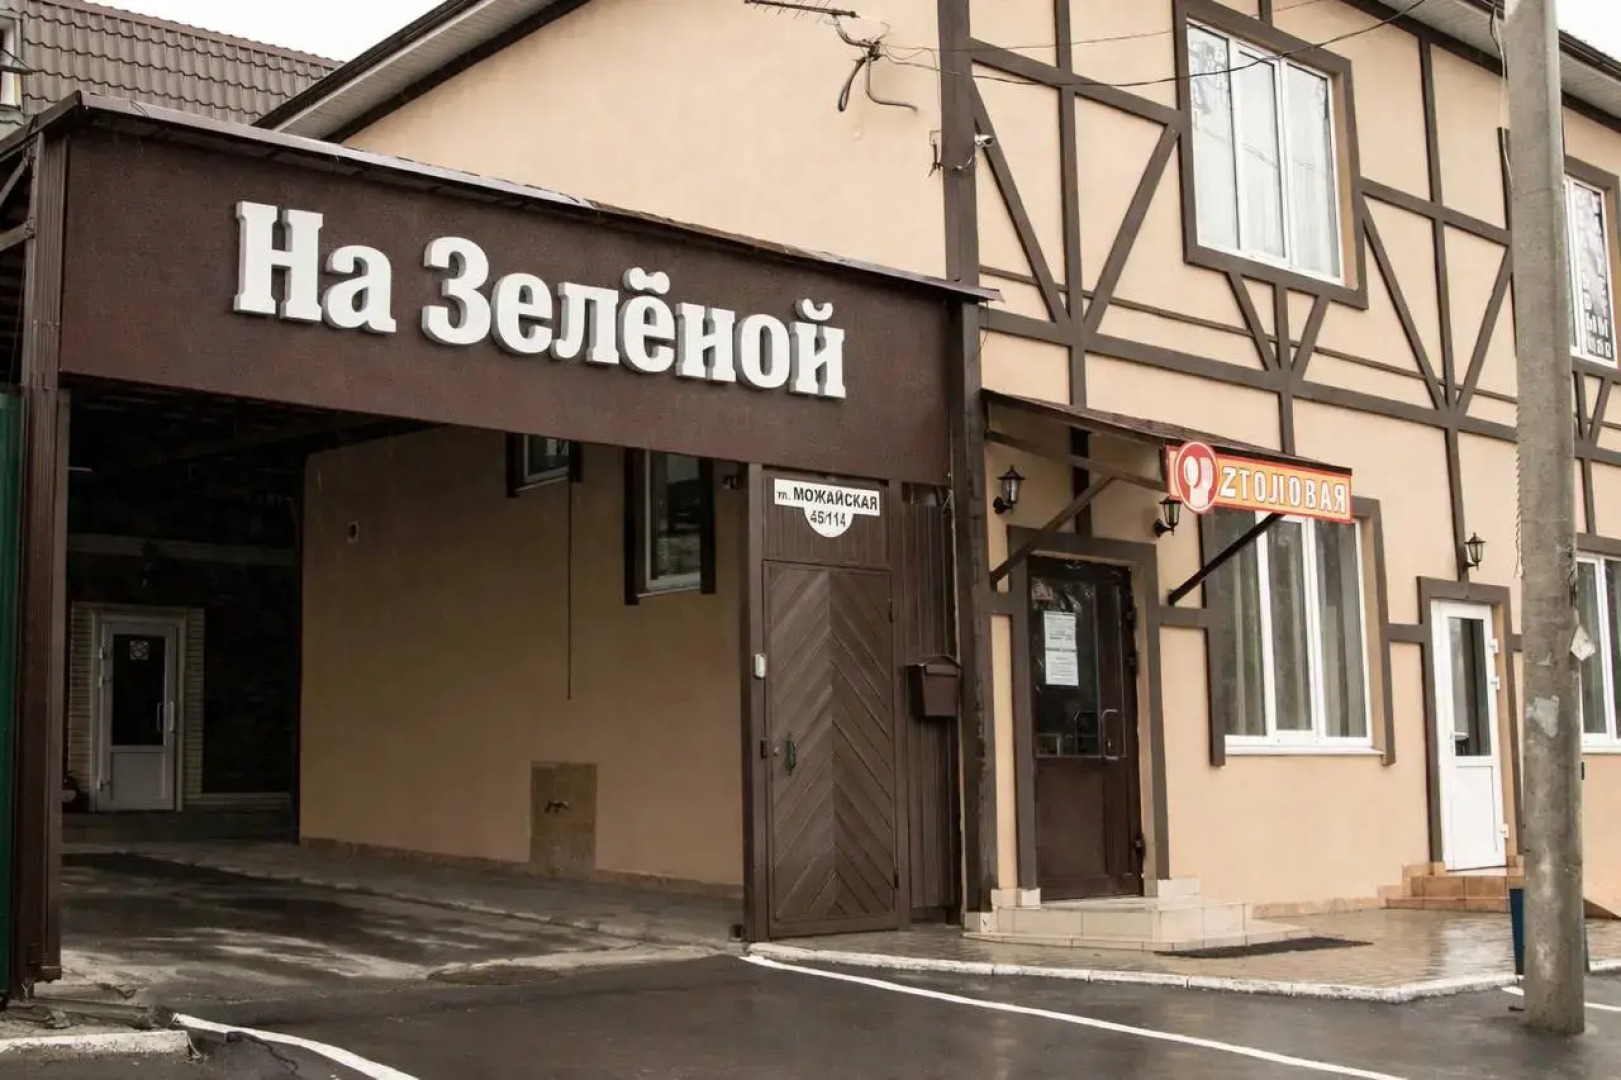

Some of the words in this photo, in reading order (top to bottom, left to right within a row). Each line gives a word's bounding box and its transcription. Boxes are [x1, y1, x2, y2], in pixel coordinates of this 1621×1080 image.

[233, 200, 397, 334] На
[421, 236, 846, 399] Зелёной
[793, 486, 877, 511] МОЖАЙСКАЯ
